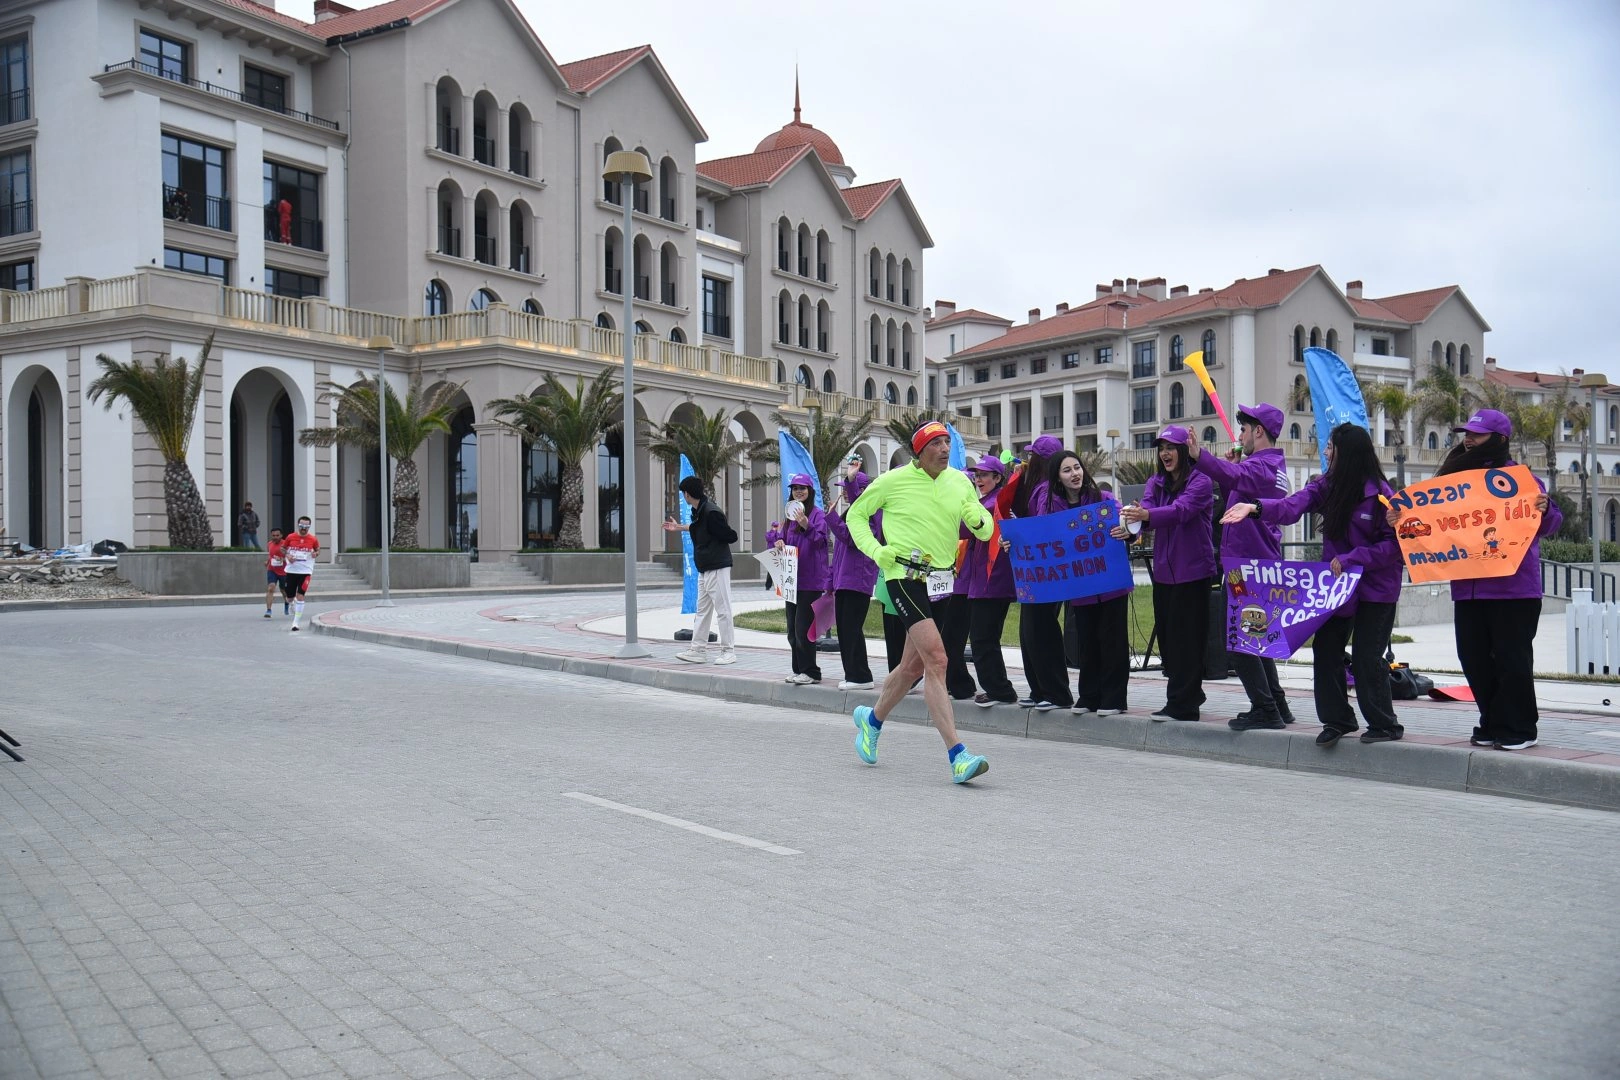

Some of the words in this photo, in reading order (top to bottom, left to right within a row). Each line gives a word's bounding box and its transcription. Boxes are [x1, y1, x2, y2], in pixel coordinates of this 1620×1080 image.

[1015, 540, 1066, 561] LET'S
[1074, 530, 1106, 553] GO
[1014, 555, 1107, 583] MARATHON
